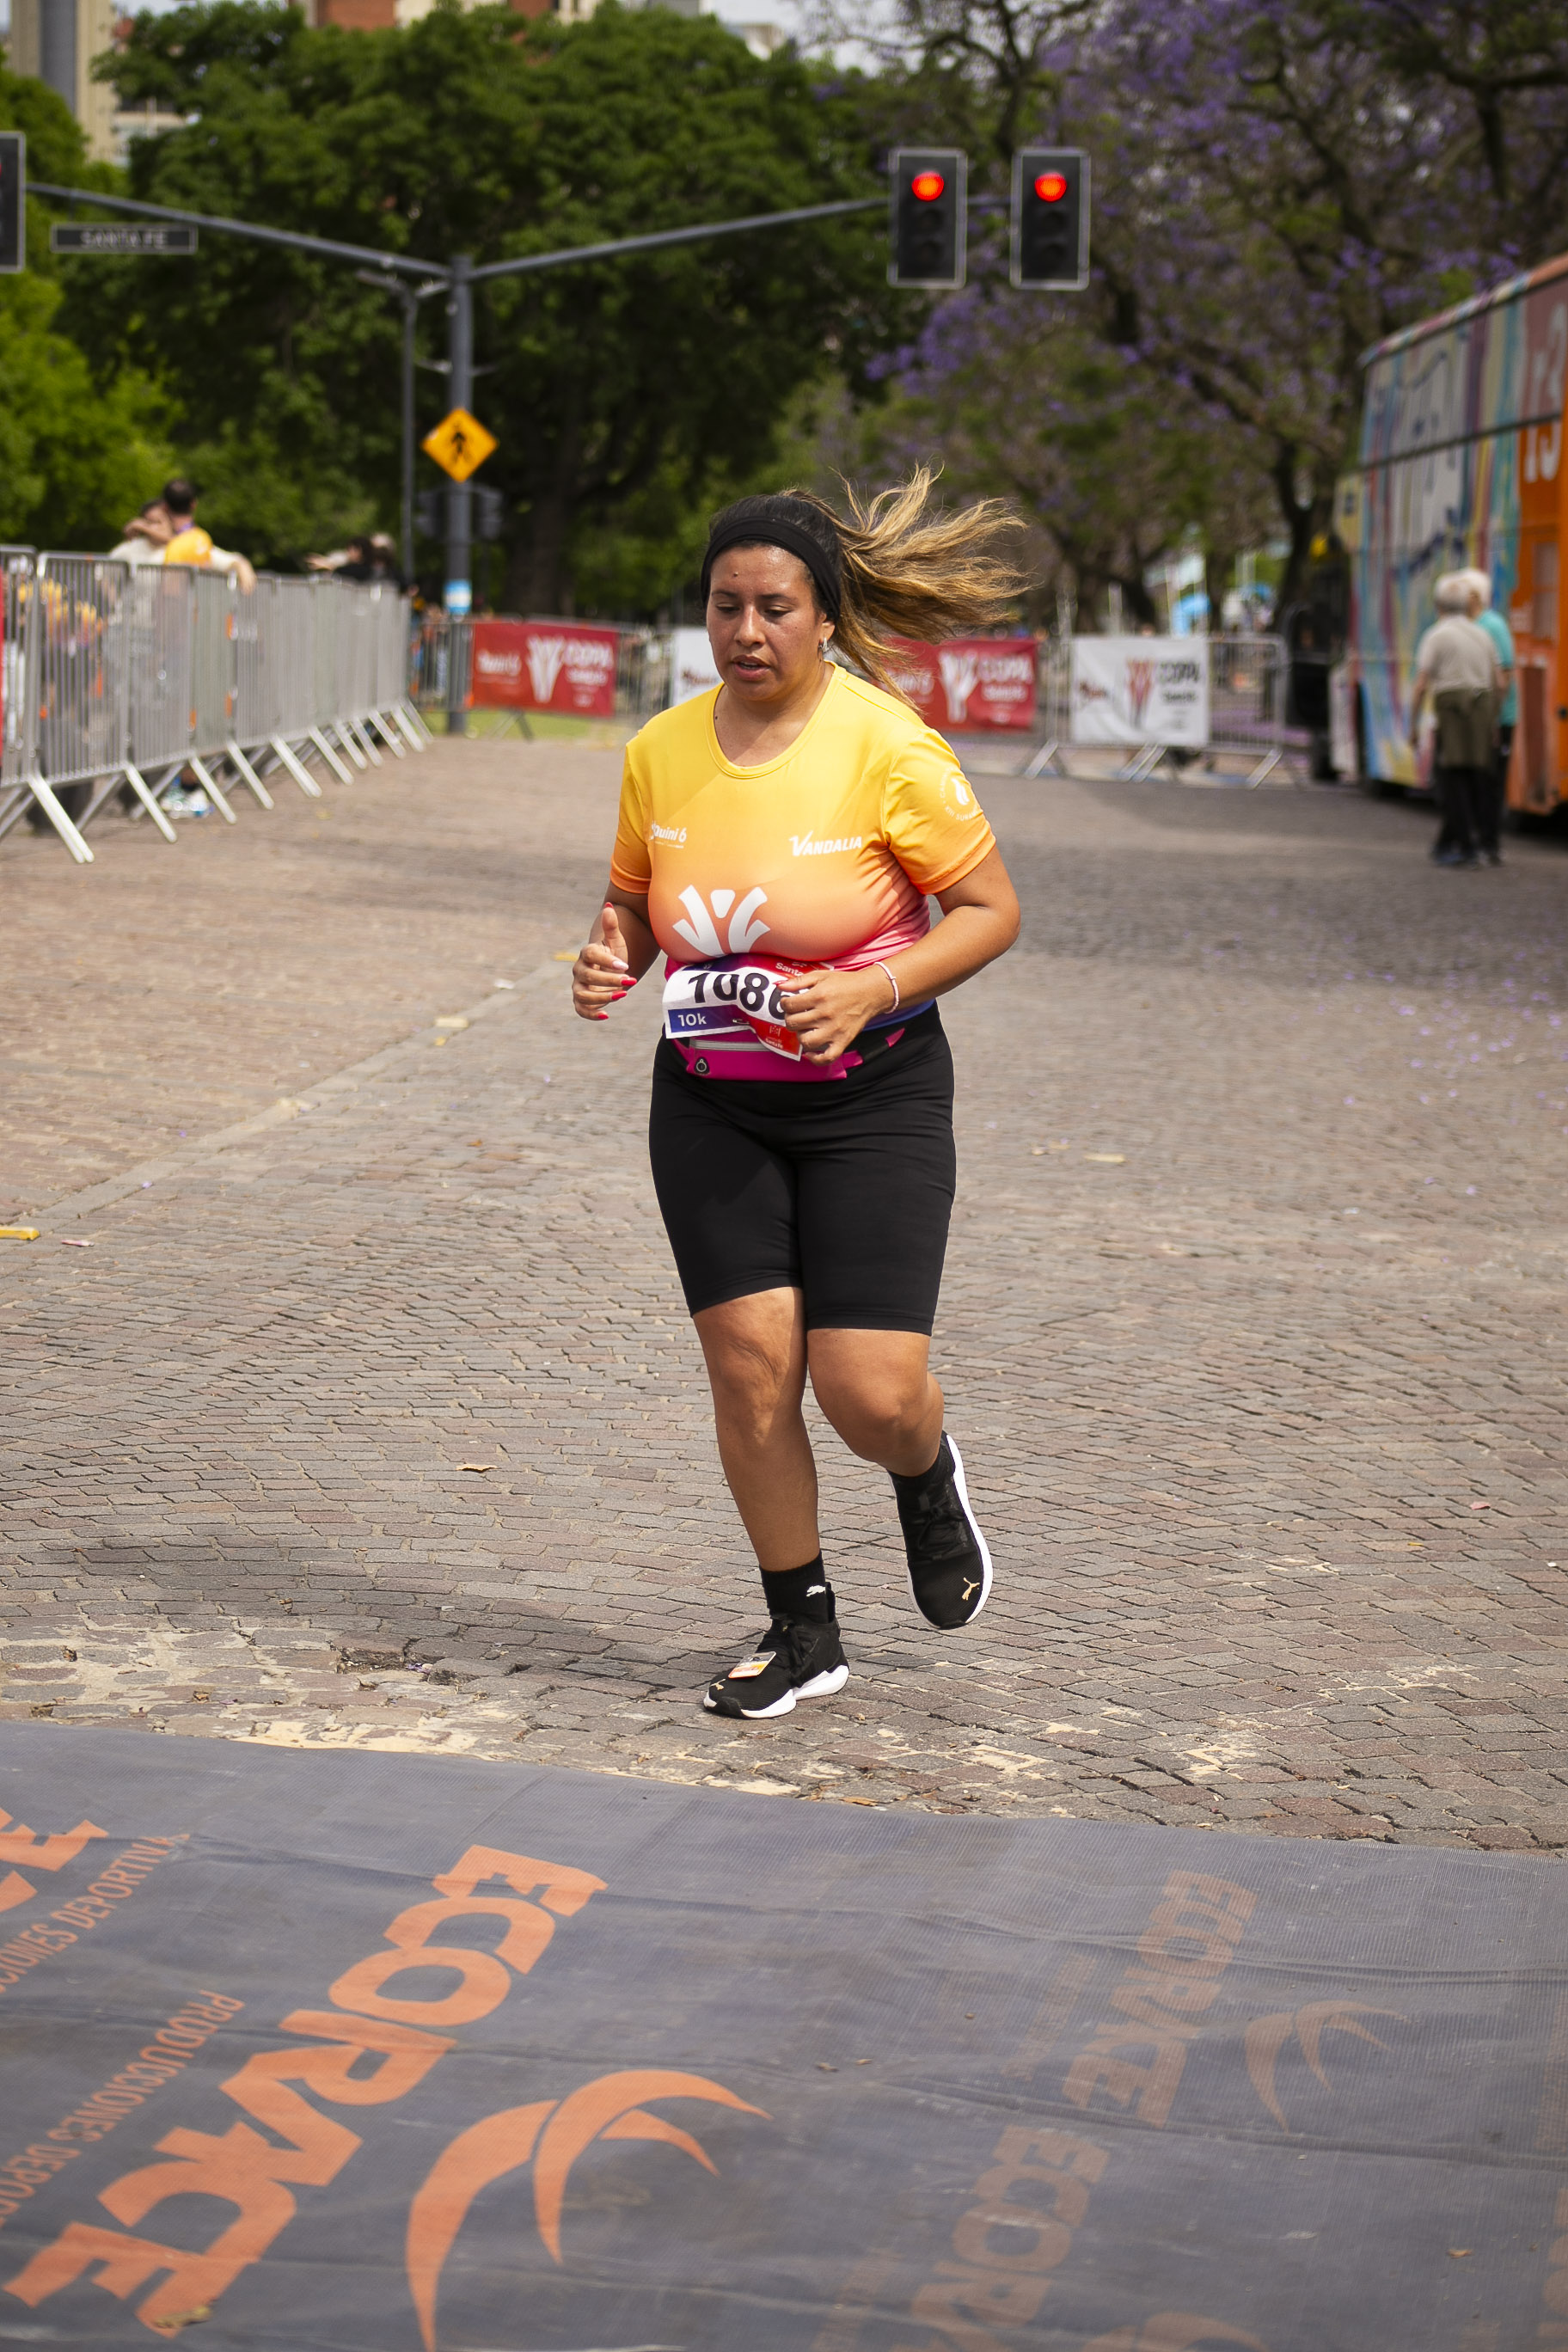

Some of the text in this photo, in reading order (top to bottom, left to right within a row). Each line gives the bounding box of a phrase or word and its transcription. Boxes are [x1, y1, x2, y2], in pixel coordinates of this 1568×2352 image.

[81, 229, 168, 248] SANTA FE
[678, 827, 687, 843] 6
[788, 830, 862, 857] VANDALIA
[677, 1013, 707, 1027] 10k
[1062, 1869, 1257, 2129] ECORACE
[3, 1845, 608, 2338] ECORACE
[0, 1989, 246, 2229] PRODUCCIONES DEPO
